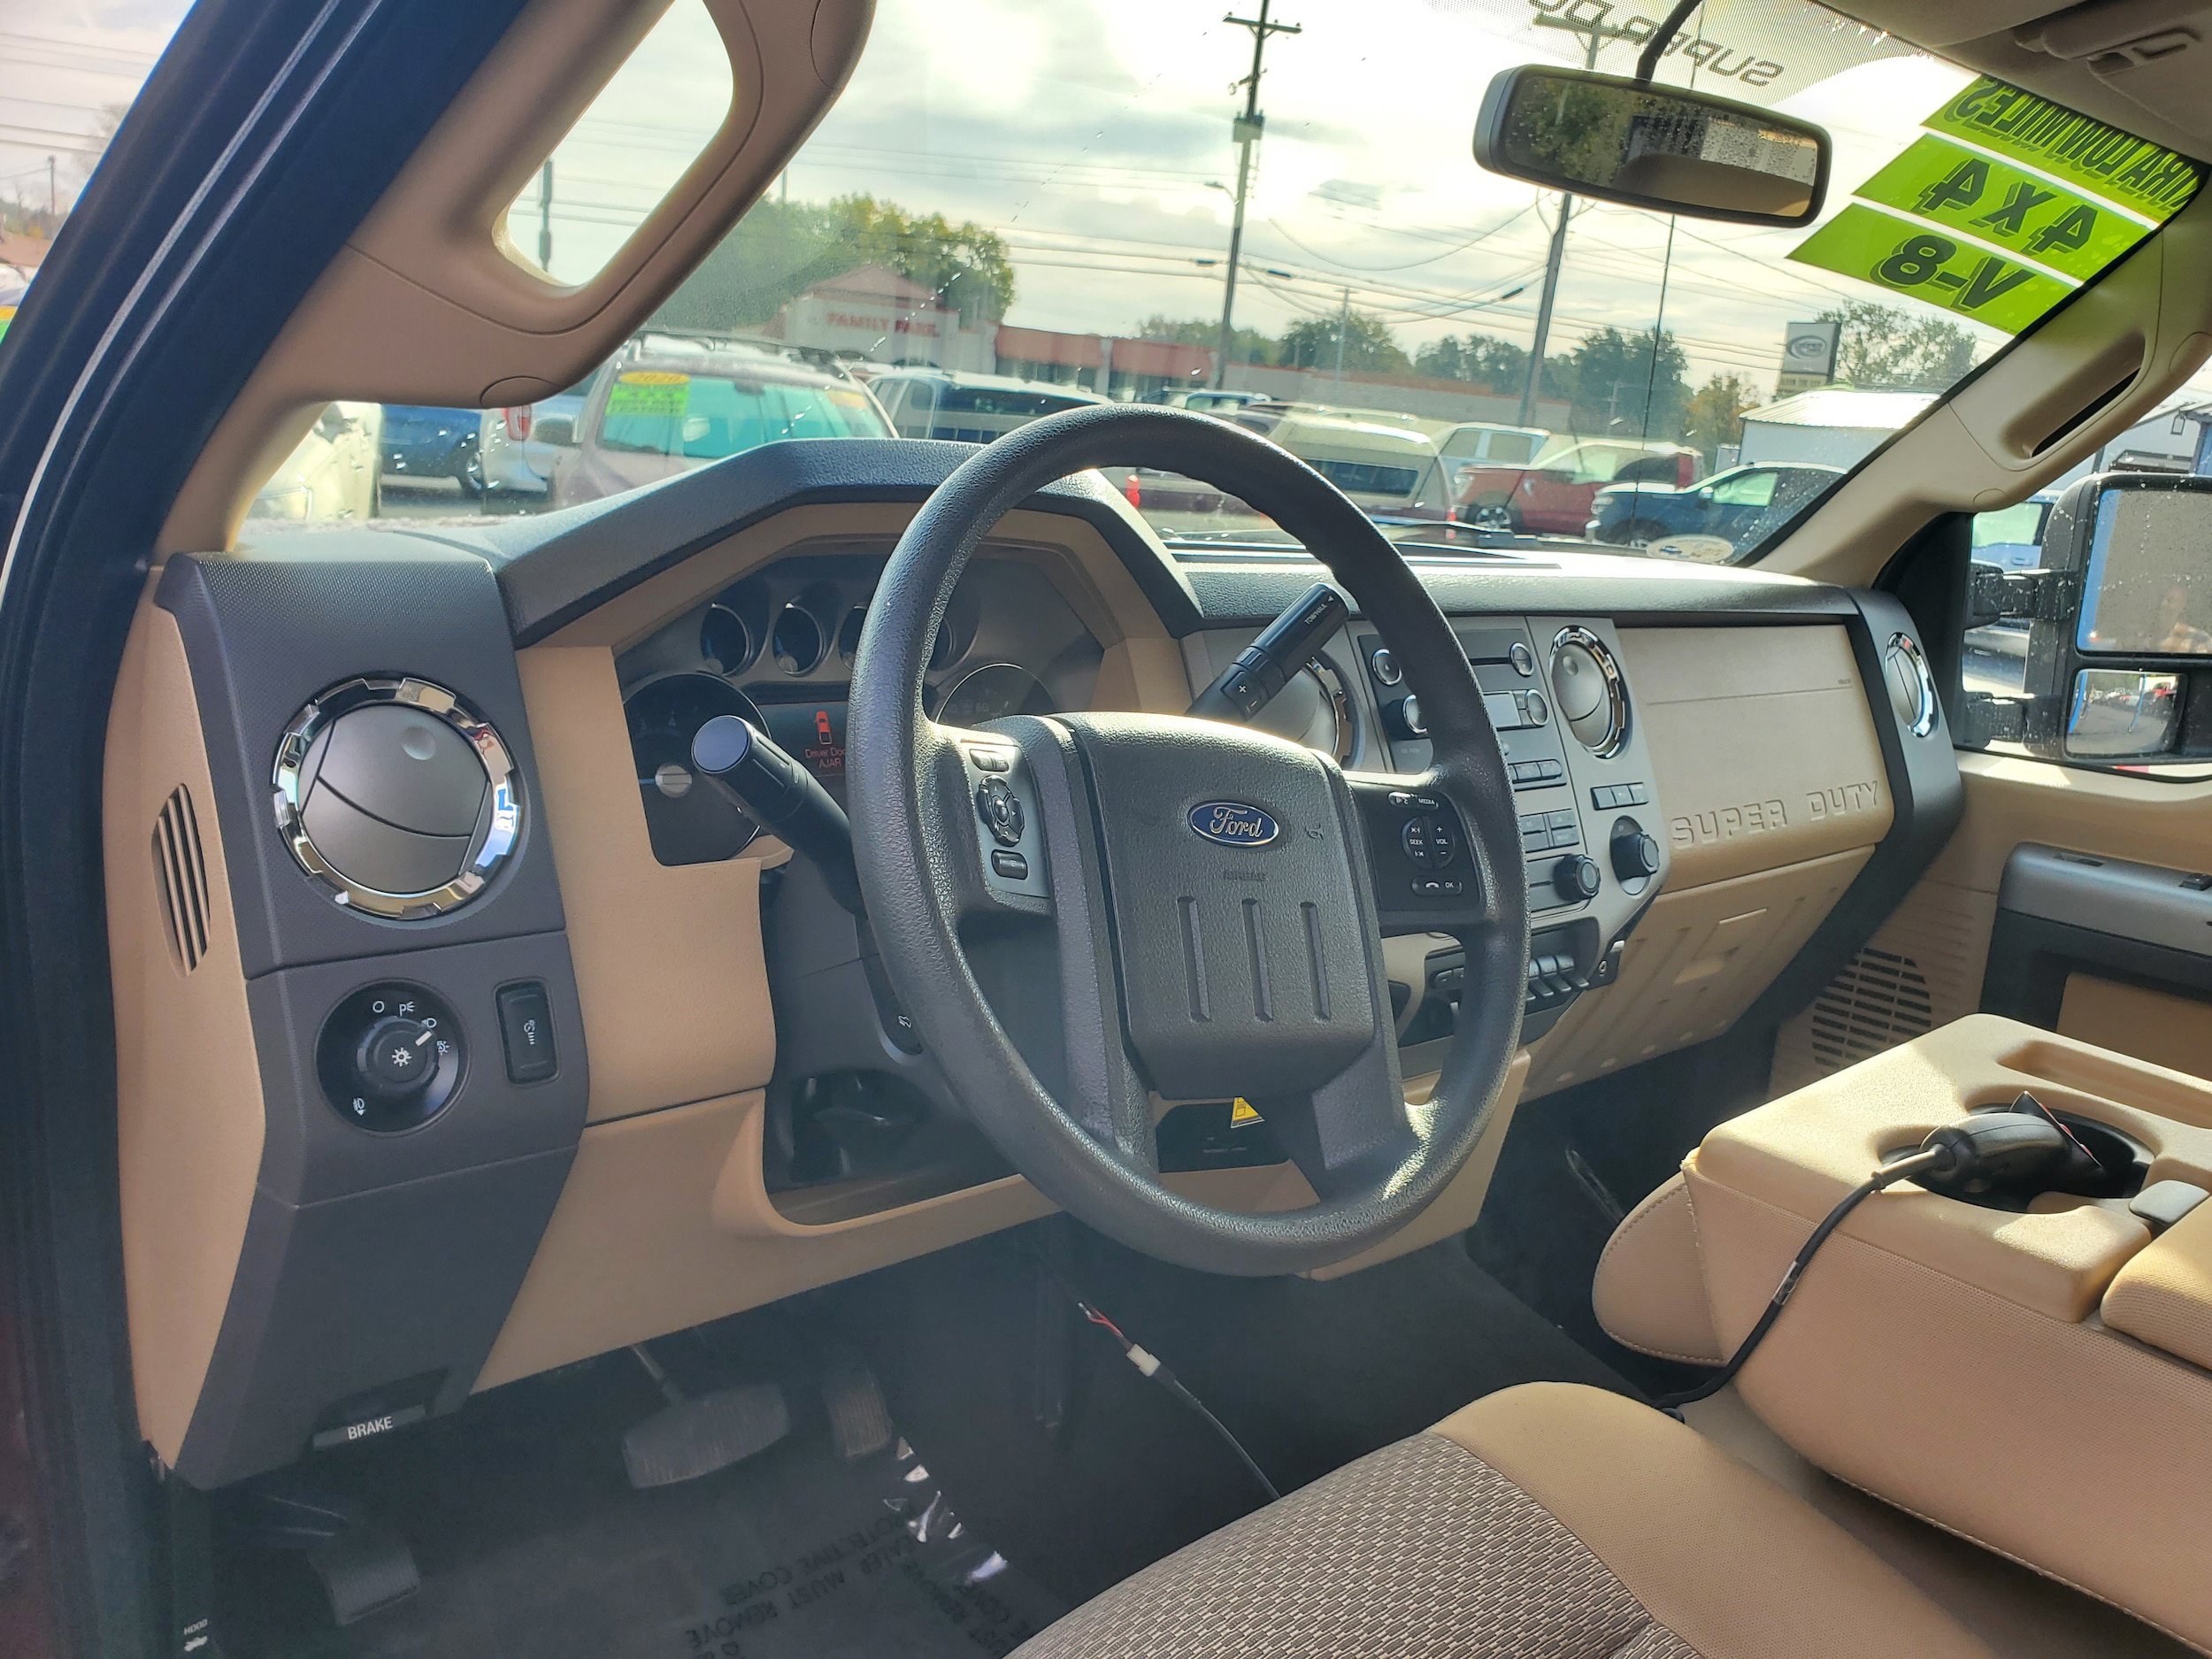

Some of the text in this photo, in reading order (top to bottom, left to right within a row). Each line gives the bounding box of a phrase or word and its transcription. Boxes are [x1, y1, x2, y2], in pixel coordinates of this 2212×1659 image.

[818, 757, 842, 769] AJAR
[830, 747, 846, 757] Doo
[1209, 805, 1264, 839] Ford
[1671, 780, 1878, 849] SUPER DUTY
[347, 1416, 394, 1440] BRAKE
